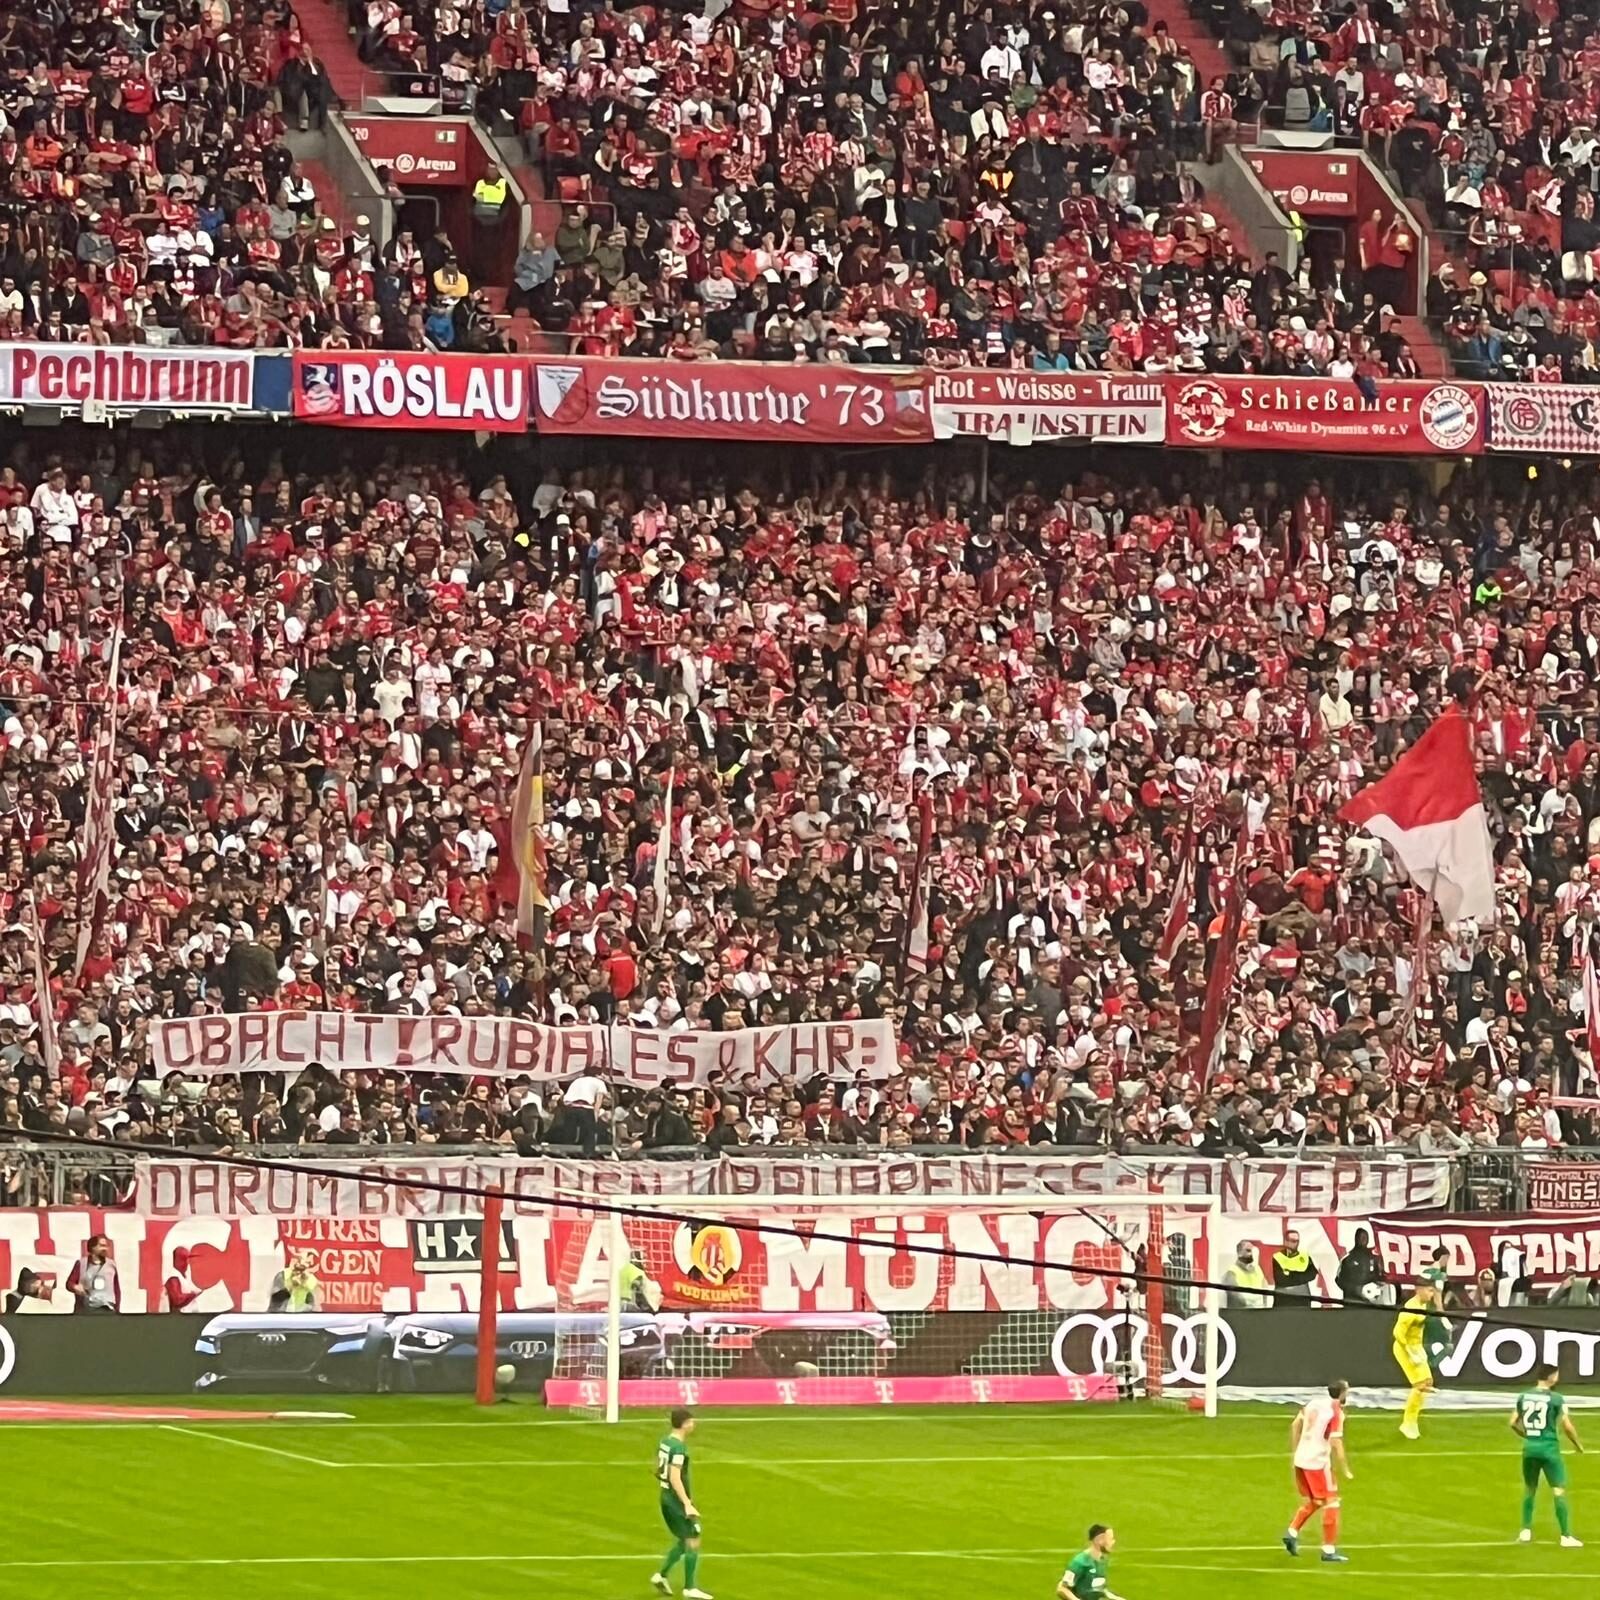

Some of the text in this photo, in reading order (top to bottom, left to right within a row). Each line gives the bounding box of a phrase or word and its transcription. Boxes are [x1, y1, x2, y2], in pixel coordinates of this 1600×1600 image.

[416, 157, 456, 171] Arena
[13, 348, 249, 403] Pechbrunn
[342, 359, 522, 421] RÖSLAU
[934, 375, 975, 399] Rot
[996, 377, 1077, 401] Weisse
[597, 375, 811, 425] Südkurve
[820, 384, 885, 426] '73
[952, 411, 1147, 435] TRANSTEIN
[1377, 1230, 1475, 1276] RED
[1522, 1400, 1548, 1430] 23
